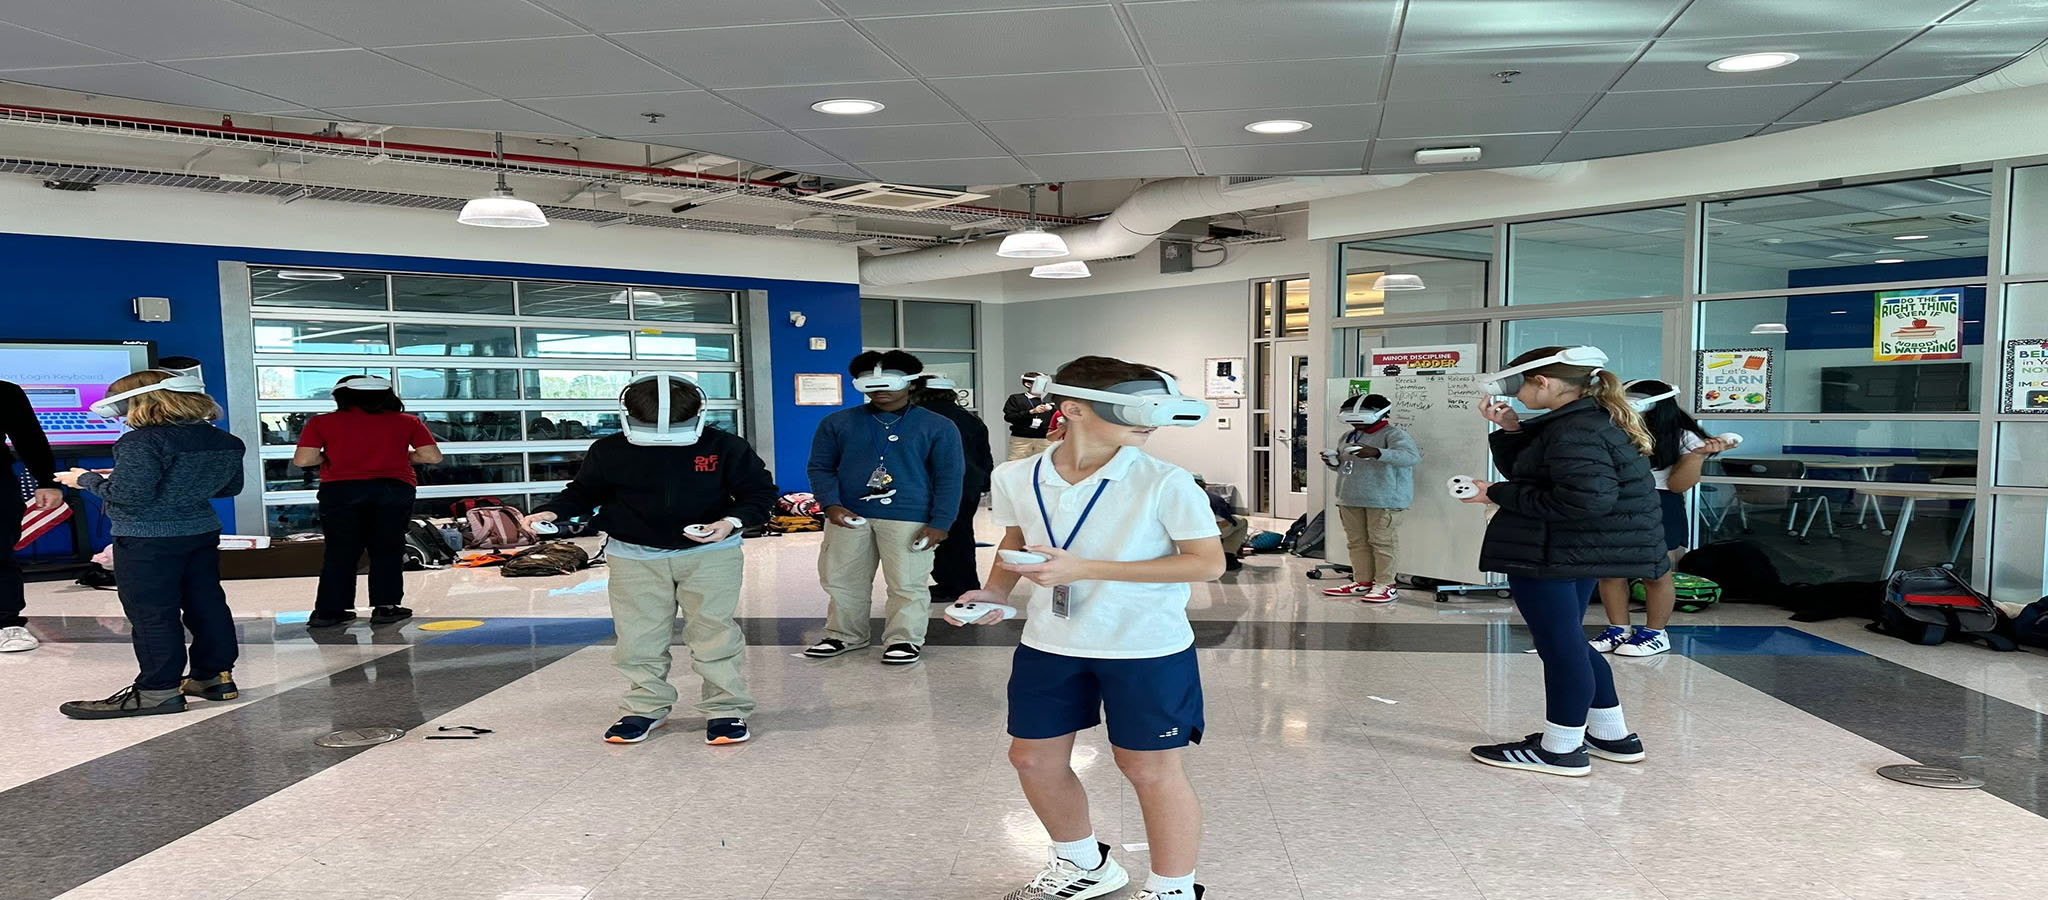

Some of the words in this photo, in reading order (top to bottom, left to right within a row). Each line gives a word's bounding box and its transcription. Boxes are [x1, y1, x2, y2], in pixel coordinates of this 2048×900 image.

[1882, 304, 1916, 318] RIGHT
[1920, 301, 1957, 314] THING
[1896, 310, 1927, 319] EVEN
[1881, 341, 1891, 354] IS
[1894, 339, 1956, 354] WATCHING
[1895, 339, 1938, 348] NOBODY
[1407, 359, 1458, 369] LADDER
[1705, 375, 1763, 385] LEARN
